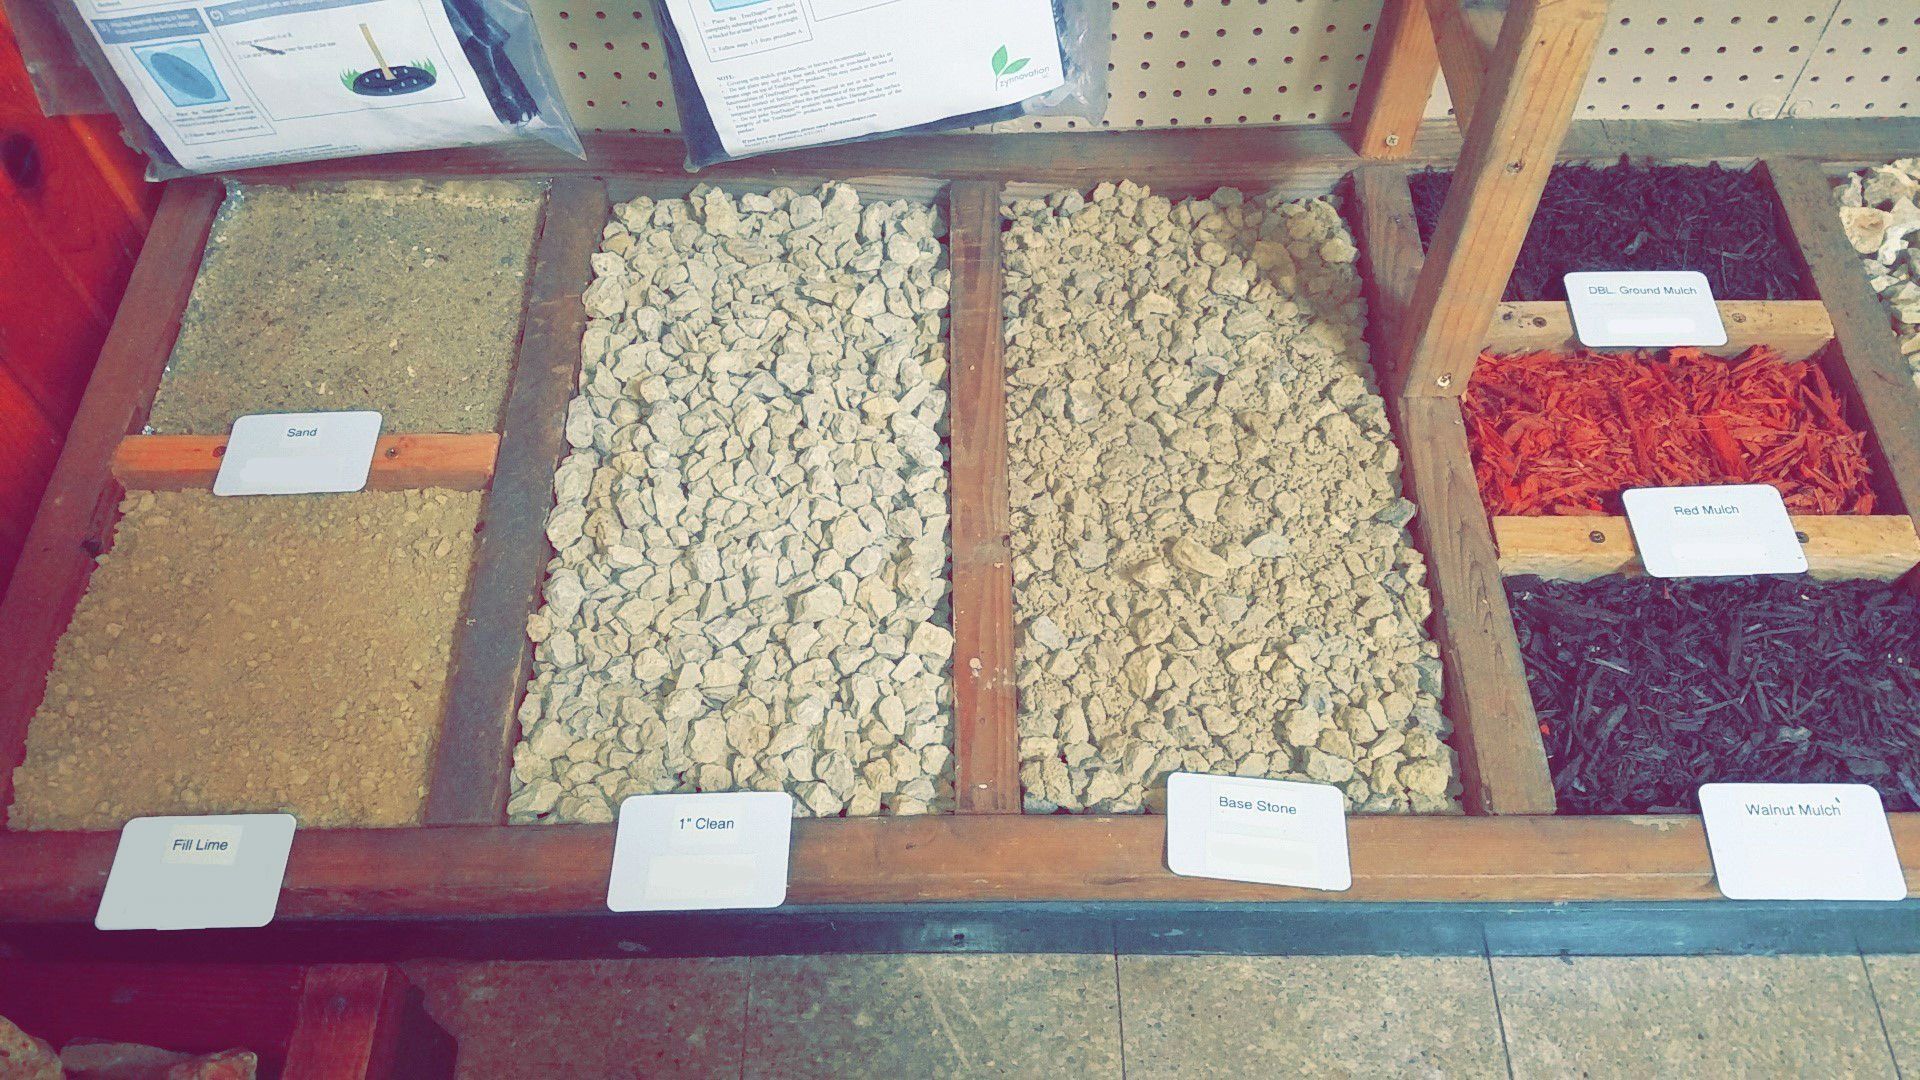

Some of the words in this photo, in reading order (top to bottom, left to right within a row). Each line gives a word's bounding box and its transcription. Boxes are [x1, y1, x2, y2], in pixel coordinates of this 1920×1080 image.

[1000, 66, 1050, 87] zynnovation
[1619, 286, 1661, 296] Ground
[1663, 286, 1698, 295] Mulch
[287, 428, 318, 437] Sand
[1674, 505, 1700, 516] Red
[1702, 505, 1740, 515] Mulch
[1219, 796, 1253, 810] Base
[1257, 800, 1297, 815] Stone
[1745, 803, 1795, 816] Walnut
[1799, 803, 1841, 816] Mulch
[695, 818, 734, 830] Clean
[172, 839, 193, 851] Fill
[196, 839, 229, 851] Lime
